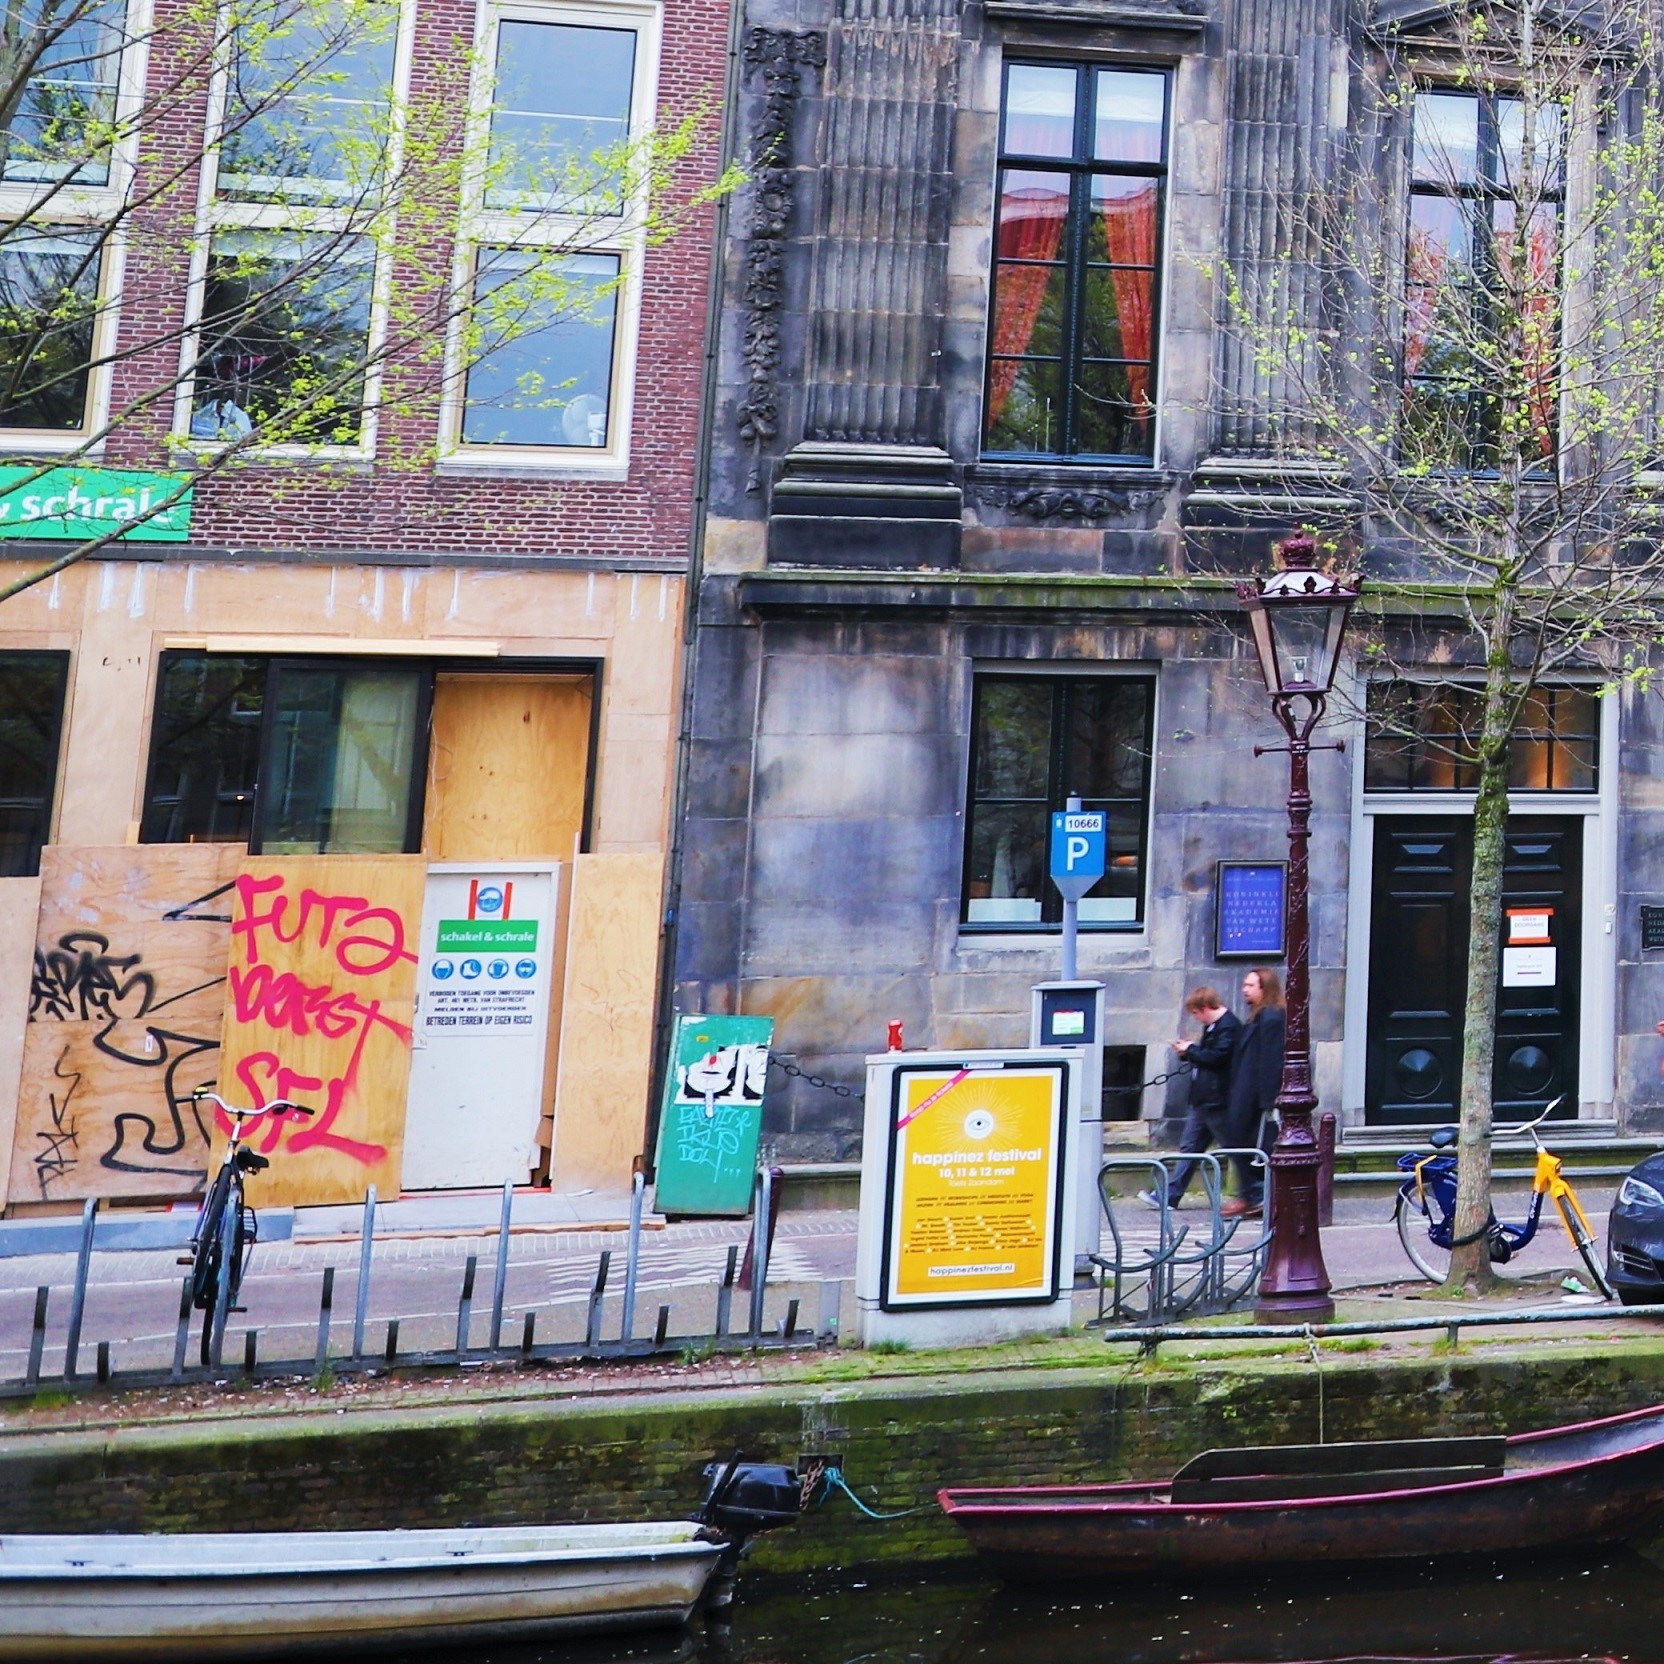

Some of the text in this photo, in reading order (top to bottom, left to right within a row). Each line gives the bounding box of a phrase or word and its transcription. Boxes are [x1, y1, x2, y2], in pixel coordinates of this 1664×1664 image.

[1068, 819, 1099, 828] 10666
[1067, 837, 1089, 871] P
[440, 931, 535, 942] schakel & schrale
[987, 1147, 1042, 1163] festival
